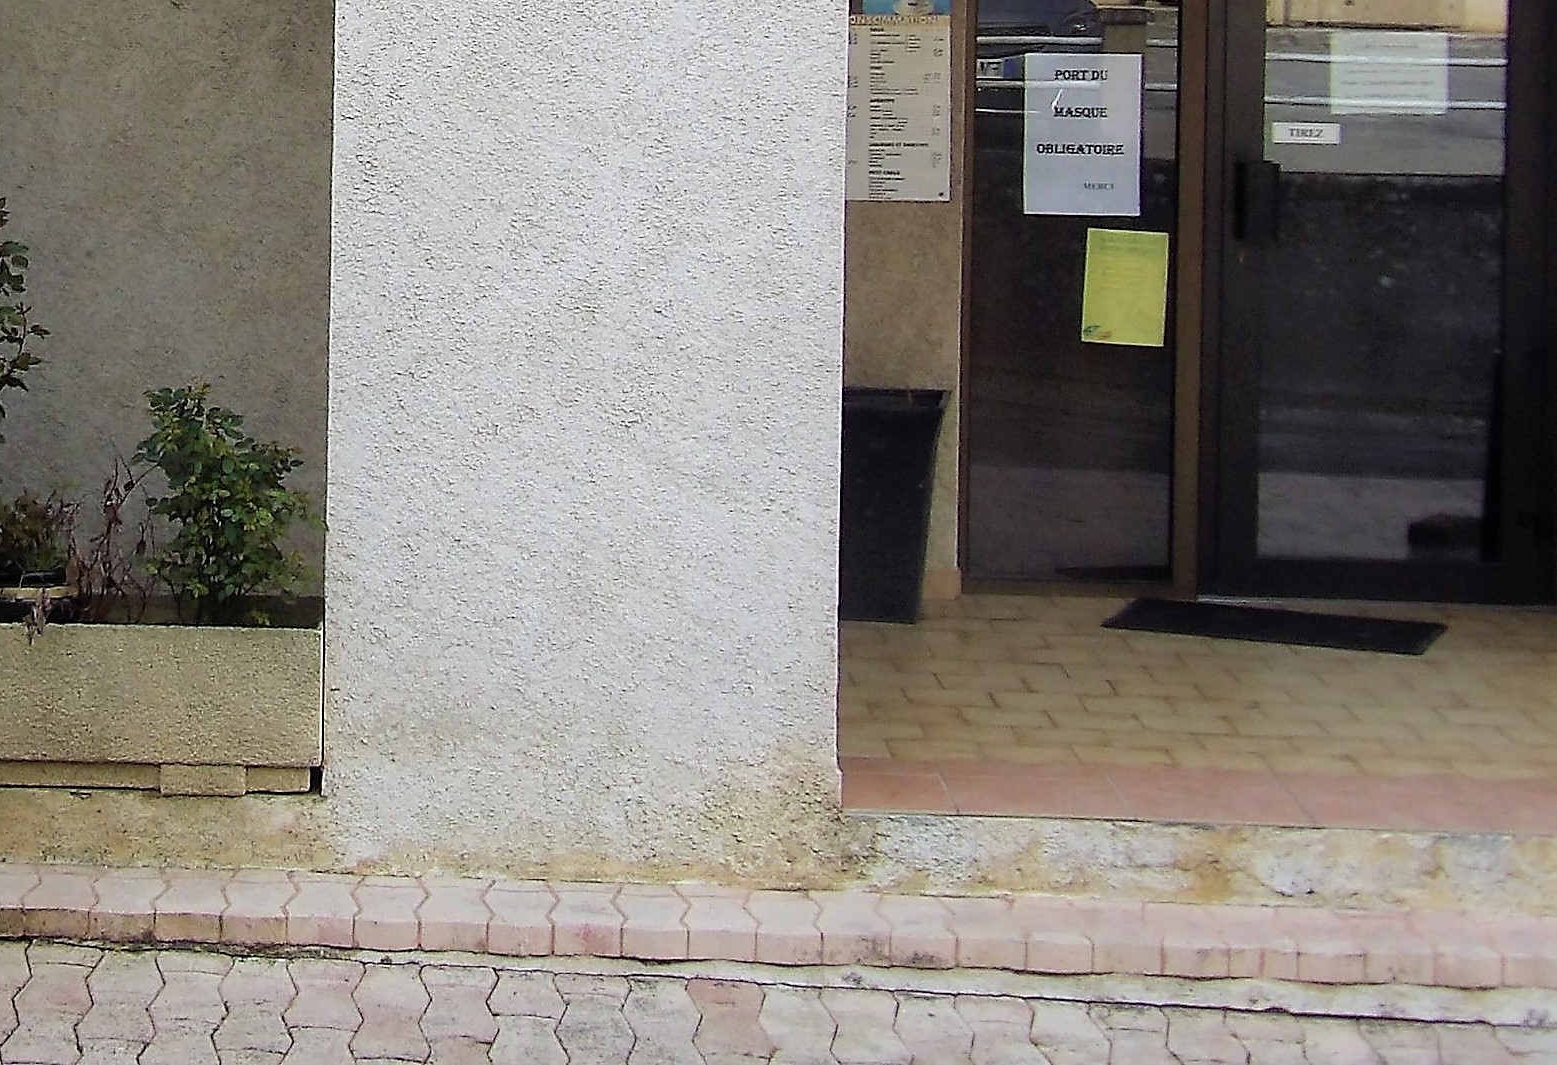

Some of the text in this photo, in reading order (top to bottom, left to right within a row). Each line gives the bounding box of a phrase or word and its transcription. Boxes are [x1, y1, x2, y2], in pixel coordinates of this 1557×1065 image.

[1054, 69, 1108, 81] PORT DU
[1053, 107, 1108, 118] MASQUE
[1036, 143, 1125, 155] OBLIGATOIRE
